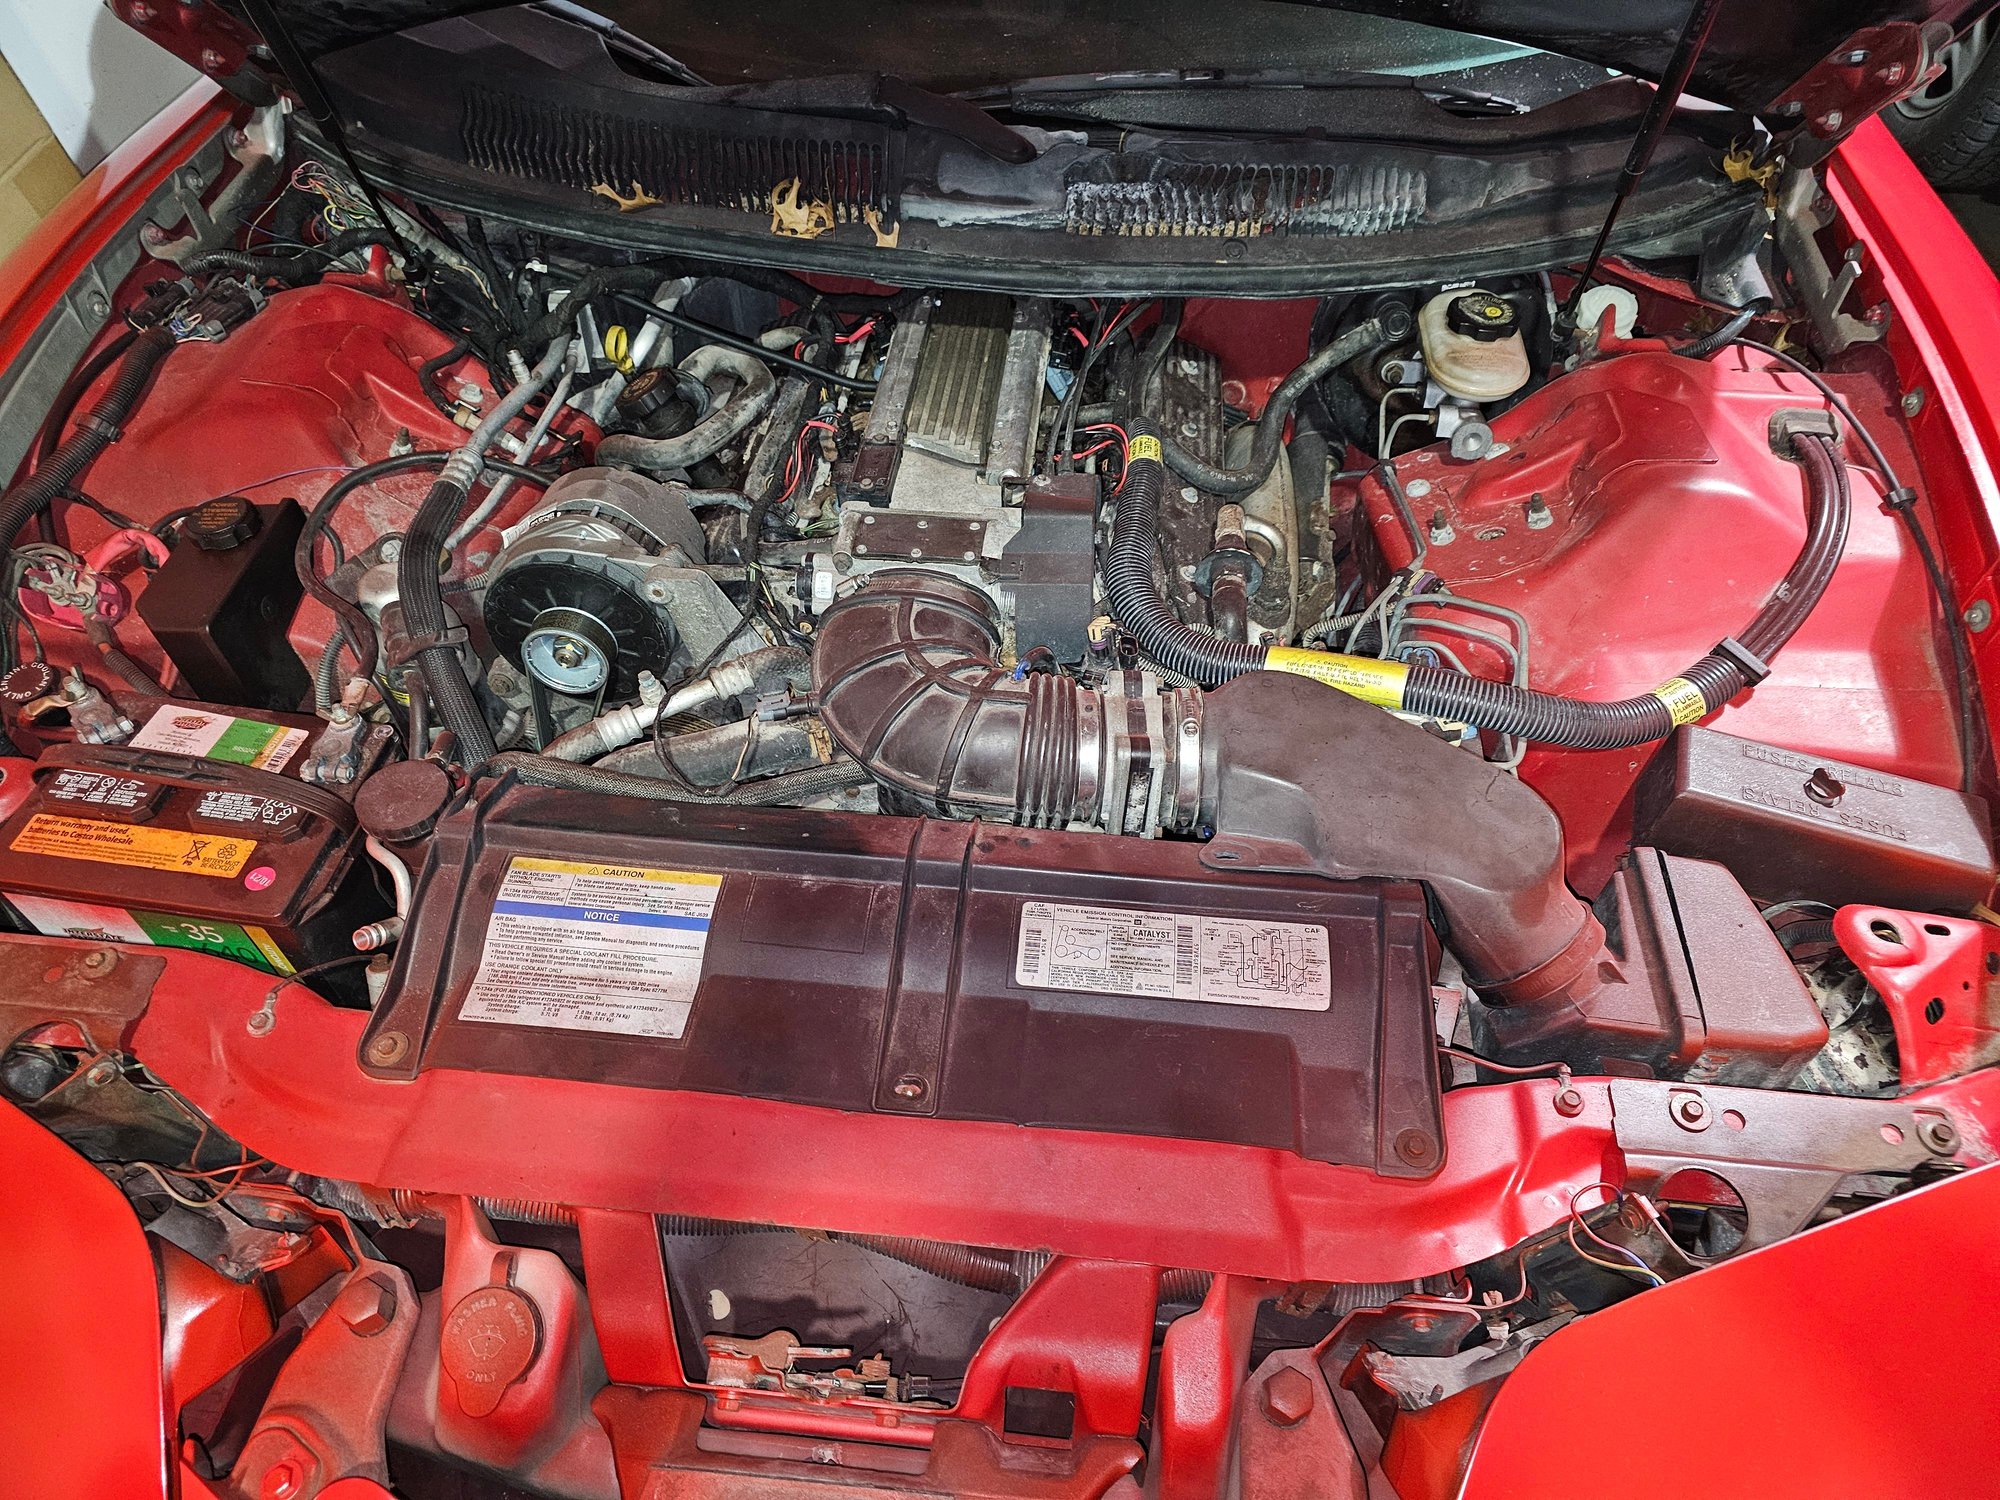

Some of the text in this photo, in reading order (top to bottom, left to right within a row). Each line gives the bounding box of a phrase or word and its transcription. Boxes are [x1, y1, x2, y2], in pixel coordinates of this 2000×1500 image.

[1324, 661, 1348, 669] CAUTION
[0, 661, 51, 700] ENGINE COOLANT ONLY
[1343, 681, 1366, 689] HAZARD
[1672, 691, 1698, 708] FUEL
[1679, 704, 1704, 722] CAUTION
[1743, 743, 1904, 797] FUSES RELAYS
[1742, 786, 1907, 841] FUSES RELAYS
[34, 816, 129, 835] Return warranty and used
[27, 826, 60, 836] batteries
[70, 831, 94, 841] Costco
[94, 834, 134, 846] Wholesale
[208, 864, 235, 872] RECYCLED
[602, 868, 644, 878] CAUTION
[583, 911, 620, 921] NOTICE
[1135, 914, 1173, 922] INFORMATION
[180, 923, 225, 943] 35
[1133, 929, 1171, 939] CATALYST
[450, 1297, 498, 1336] WASHER
[466, 1369, 497, 1384] ONLY
